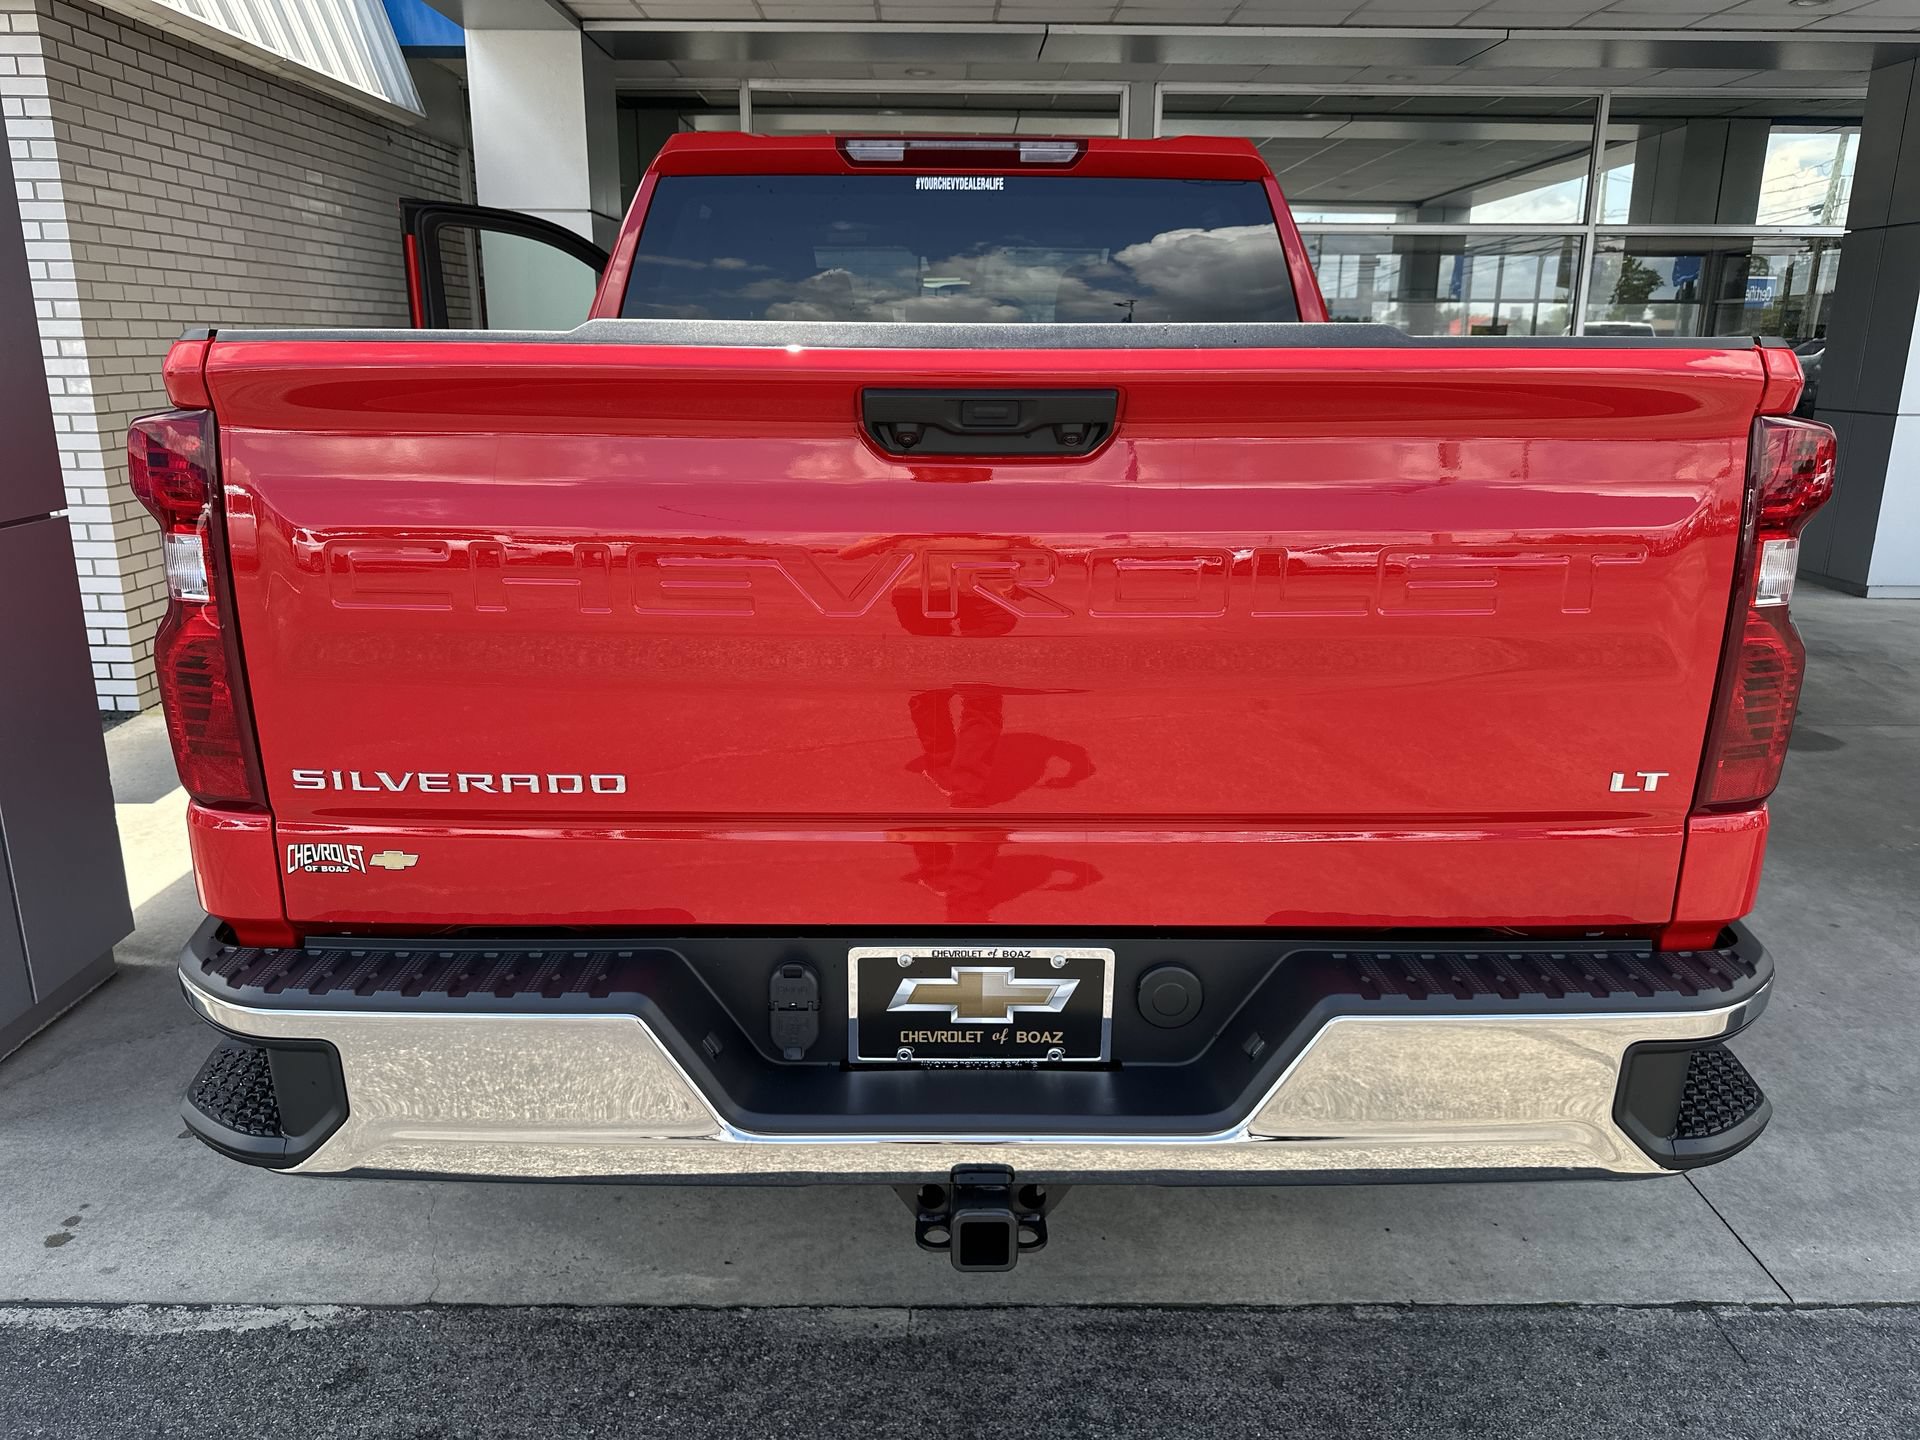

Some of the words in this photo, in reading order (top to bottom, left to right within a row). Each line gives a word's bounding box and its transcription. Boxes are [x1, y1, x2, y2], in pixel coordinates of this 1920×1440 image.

[915, 177, 1004, 190] #YOURCHEVYDEALER4LIFE
[324, 539, 1648, 618] CHEVROLET
[291, 768, 627, 794] SILVERADO
[1609, 771, 1670, 792] LT
[286, 843, 367, 875] CHEVROLET
[304, 865, 319, 873] OF
[321, 865, 350, 873] BOAZ
[931, 949, 982, 959] CHEVROLET
[987, 948, 999, 959] of
[1002, 950, 1032, 958] BOAZ
[900, 1030, 985, 1043] CHEVROLET
[992, 1028, 1009, 1045] of
[1016, 1031, 1064, 1044] BOAZ
